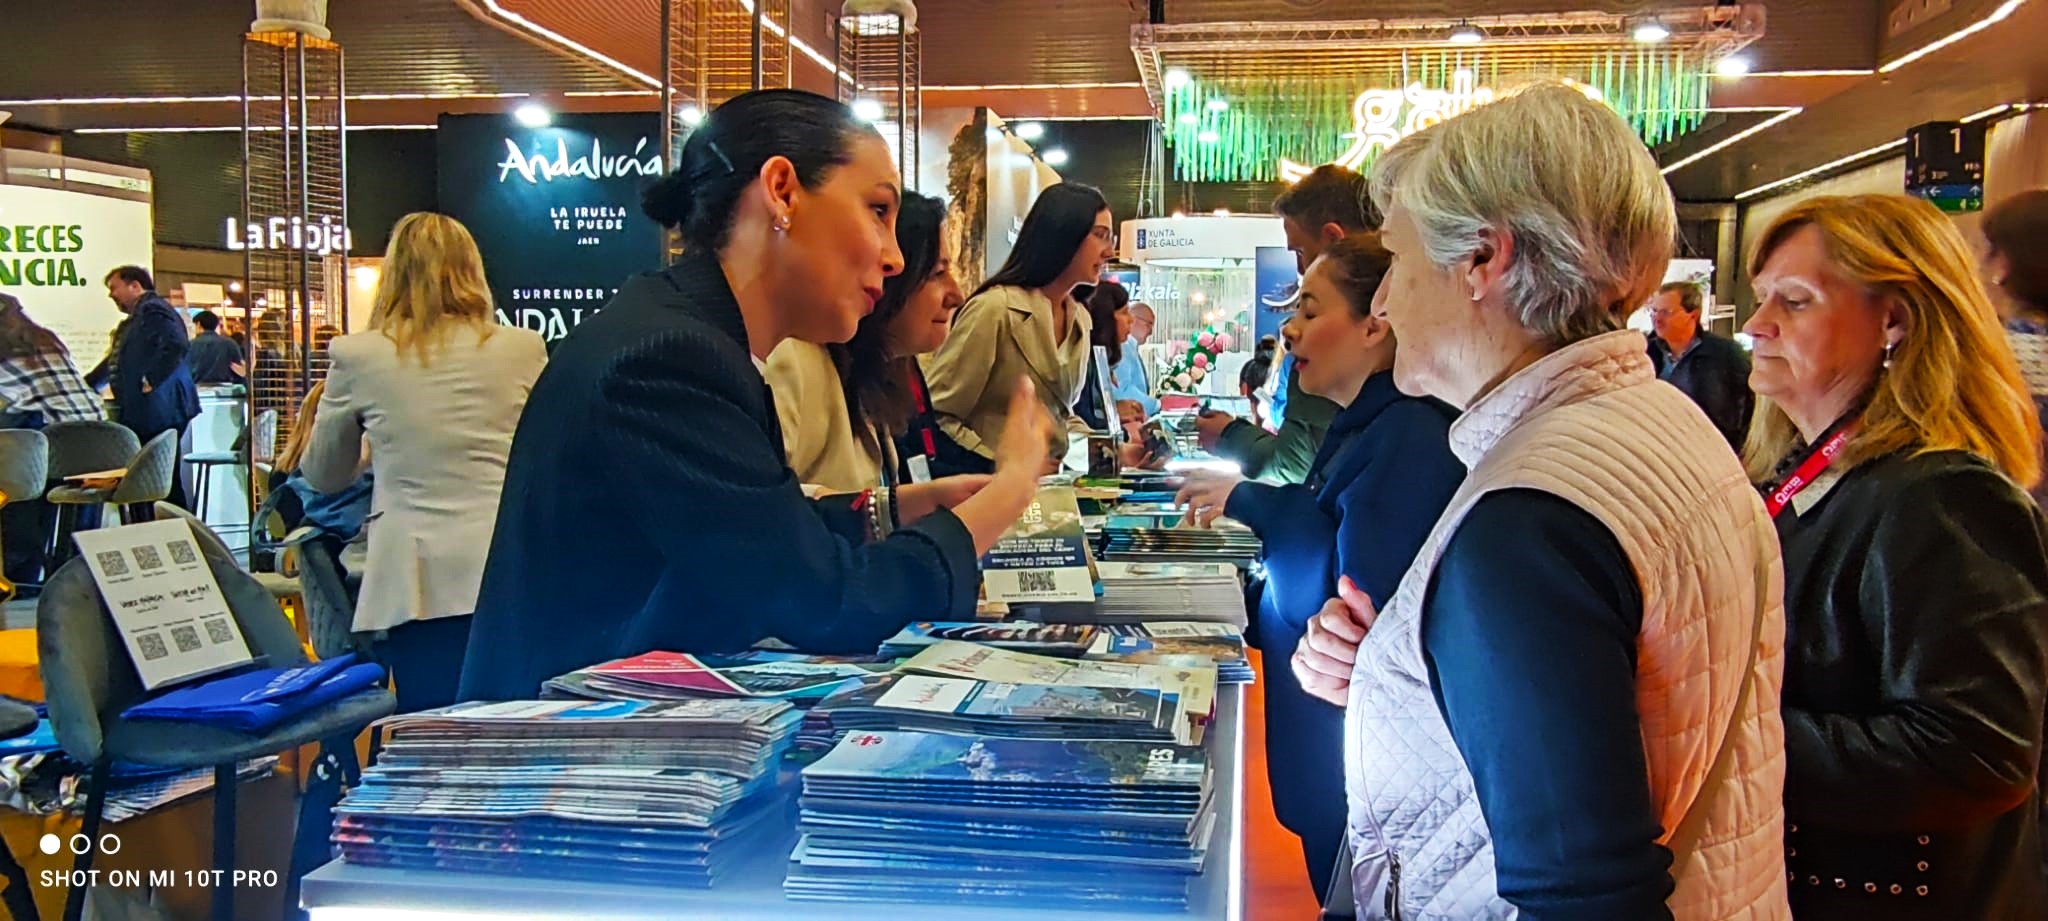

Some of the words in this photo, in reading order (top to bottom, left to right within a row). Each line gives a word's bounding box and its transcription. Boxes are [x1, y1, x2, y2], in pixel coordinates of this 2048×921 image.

[1950, 127, 1960, 154] 1
[498, 136, 663, 183] Andalucía
[551, 207, 567, 218] LA
[575, 207, 626, 217] IRUELA
[554, 220, 569, 230] TE
[577, 219, 622, 230] PUEDE
[227, 217, 264, 249] La
[268, 215, 352, 256] Rioja
[1148, 239, 1158, 247] DE
[1160, 238, 1194, 247] GALICIA
[513, 289, 604, 300] SURRENDER
